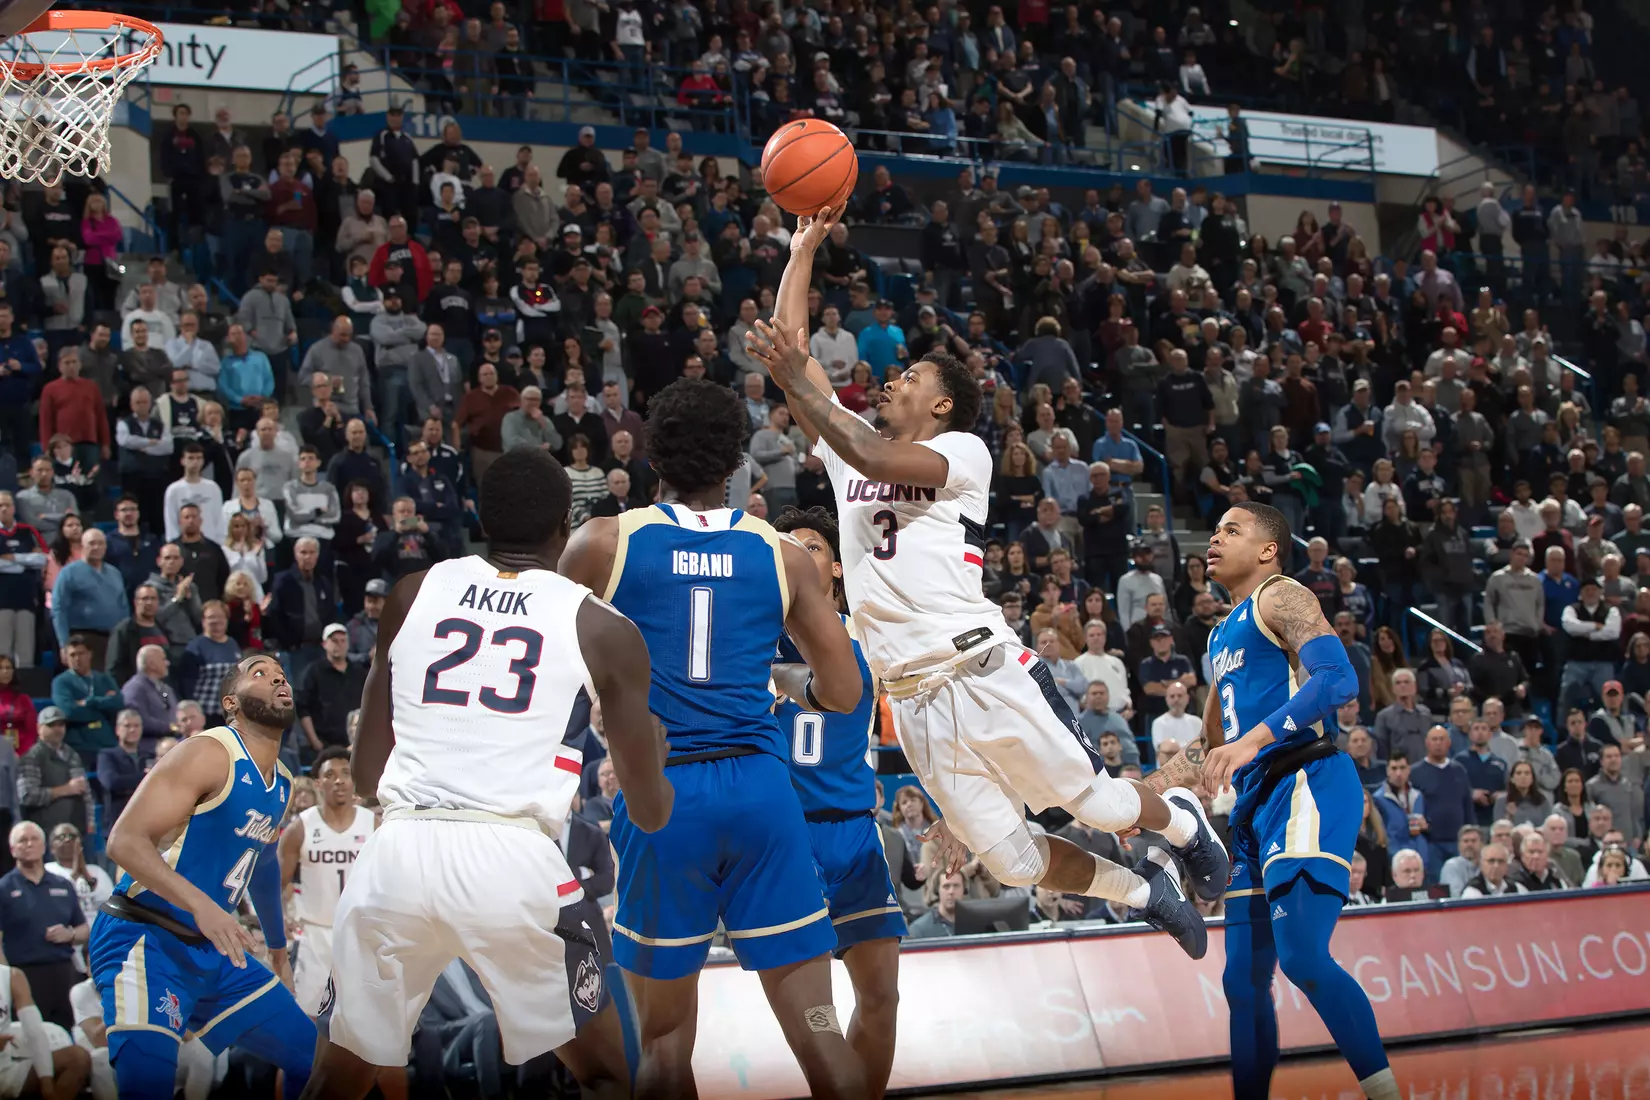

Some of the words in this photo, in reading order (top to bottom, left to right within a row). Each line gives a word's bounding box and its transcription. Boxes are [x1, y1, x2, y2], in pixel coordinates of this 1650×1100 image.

[846, 479, 936, 502] UCONN
[672, 549, 733, 578] IGBANU
[873, 509, 898, 561] 3
[458, 583, 534, 616] AKOK
[688, 586, 713, 683] 1
[421, 617, 545, 714] 23
[791, 710, 825, 767] 0
[1220, 682, 1240, 744] 3
[222, 847, 260, 906] 4
